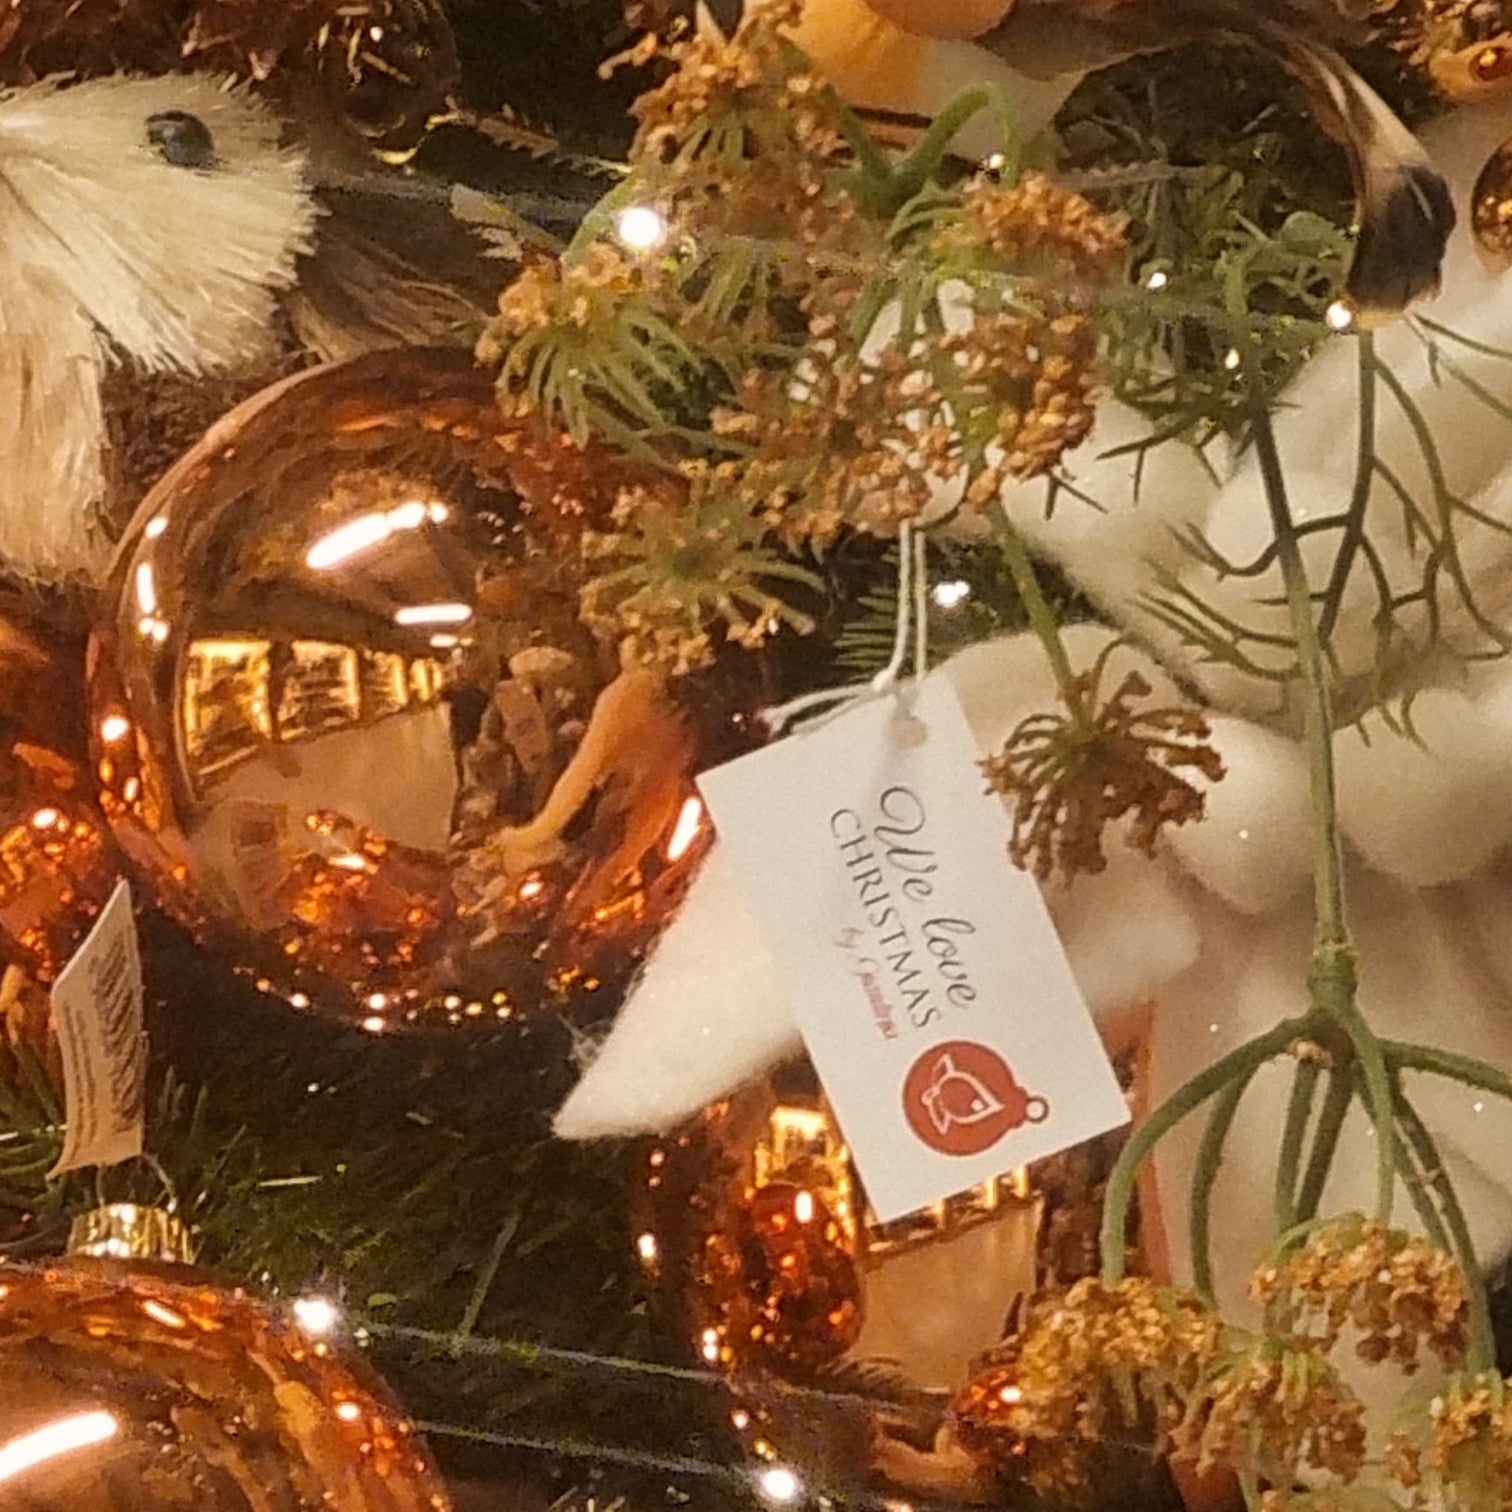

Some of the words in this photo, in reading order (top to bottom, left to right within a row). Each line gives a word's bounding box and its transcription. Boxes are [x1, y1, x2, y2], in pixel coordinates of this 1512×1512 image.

[830, 807, 943, 1030] CHRISTMAS
[874, 786, 938, 902] We
[921, 917, 977, 1009] love
